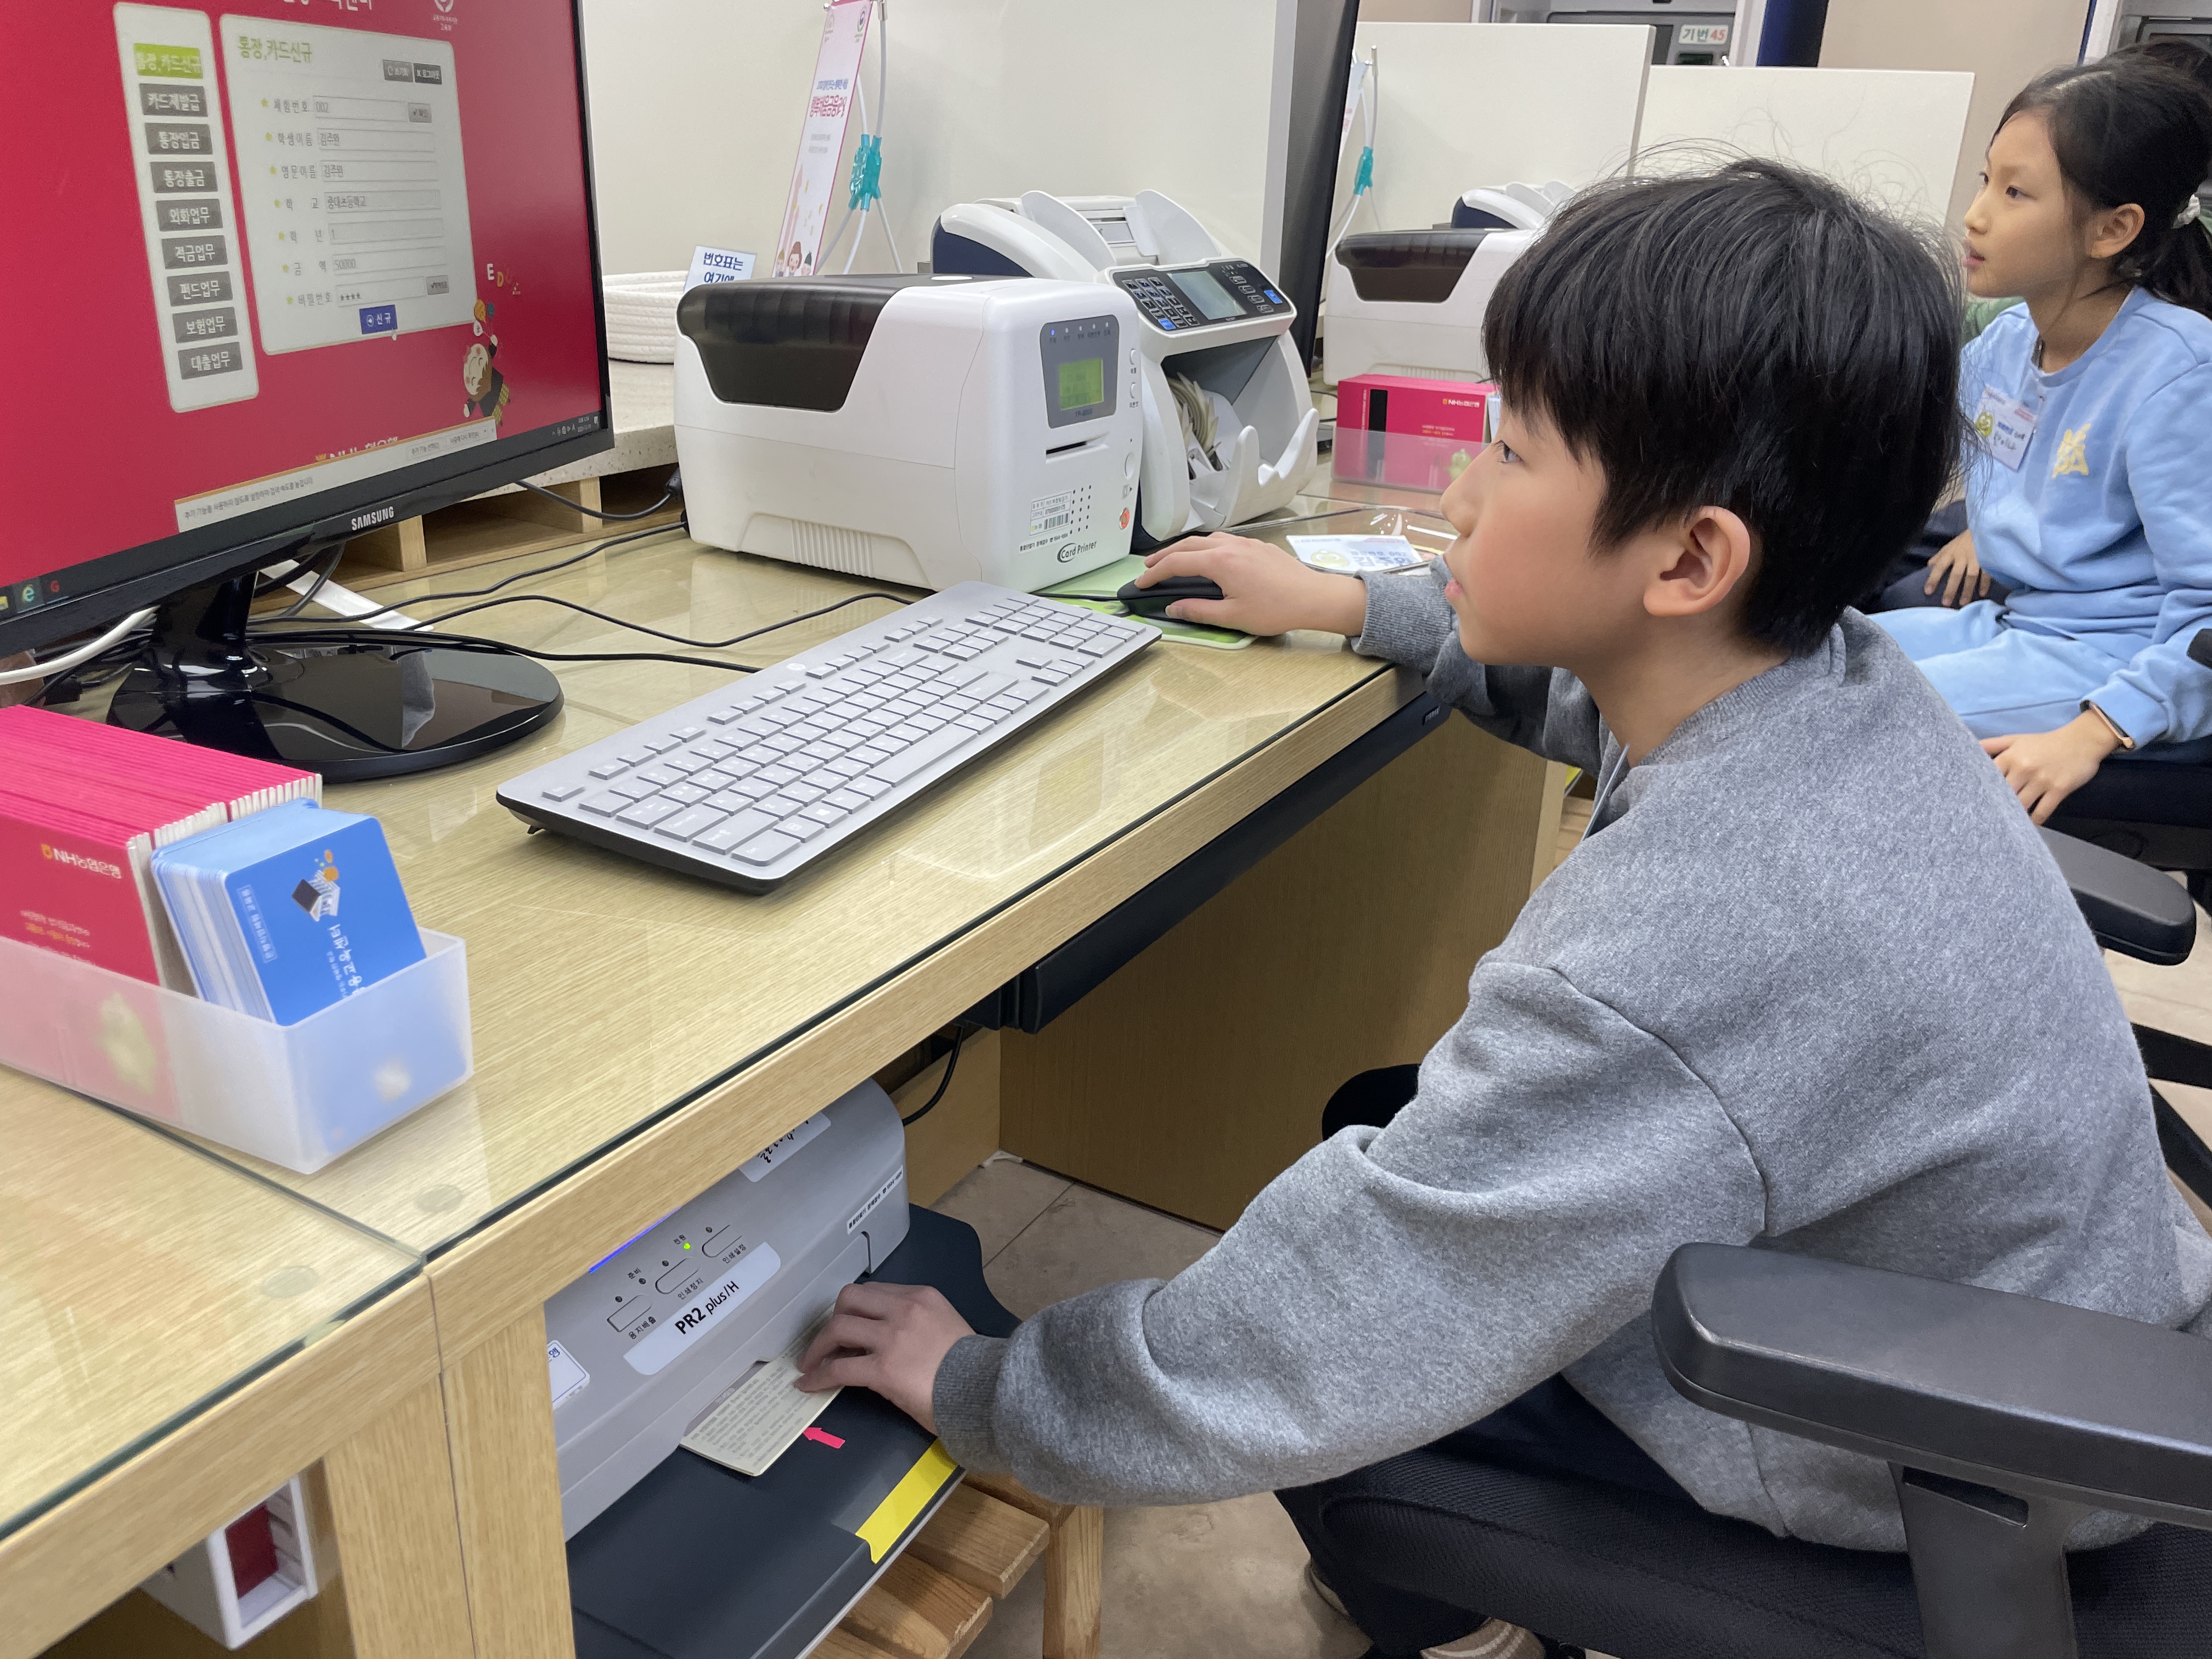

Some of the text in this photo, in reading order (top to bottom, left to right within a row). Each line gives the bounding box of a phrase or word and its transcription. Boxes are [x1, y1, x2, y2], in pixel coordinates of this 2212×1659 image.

[1682, 28, 1725, 42] 기번 45
[147, 92, 200, 111] 카드재발급
[315, 101, 329, 113] 002
[159, 131, 200, 149] 통장입금
[277, 132, 313, 146] 학생이름
[164, 169, 205, 188] 통장출금
[281, 165, 316, 179] 영문이름
[169, 206, 210, 225] 외화업무
[175, 244, 216, 262] 적금업무
[703, 252, 743, 271] 번호표는
[179, 280, 220, 300] 펀드업무
[298, 292, 331, 307] 비밀번호
[186, 316, 225, 335] 보험업무
[376, 313, 391, 326] 신규
[191, 351, 231, 371] 대출업무
[351, 506, 394, 531] SAMSUNG
[1061, 540, 1097, 559] Card Printer
[53, 848, 122, 879] NH농협은행
[328, 923, 363, 988] 융교육센터
[673, 1234, 687, 1245] 전원
[721, 1243, 747, 1264] 인쇄설정
[627, 1267, 642, 1280] 준비
[678, 1277, 704, 1300] 인쇄정지
[675, 1280, 740, 1335] PR2 plus/H
[628, 1316, 657, 1340] 용지배출
[549, 1347, 560, 1358] 행
